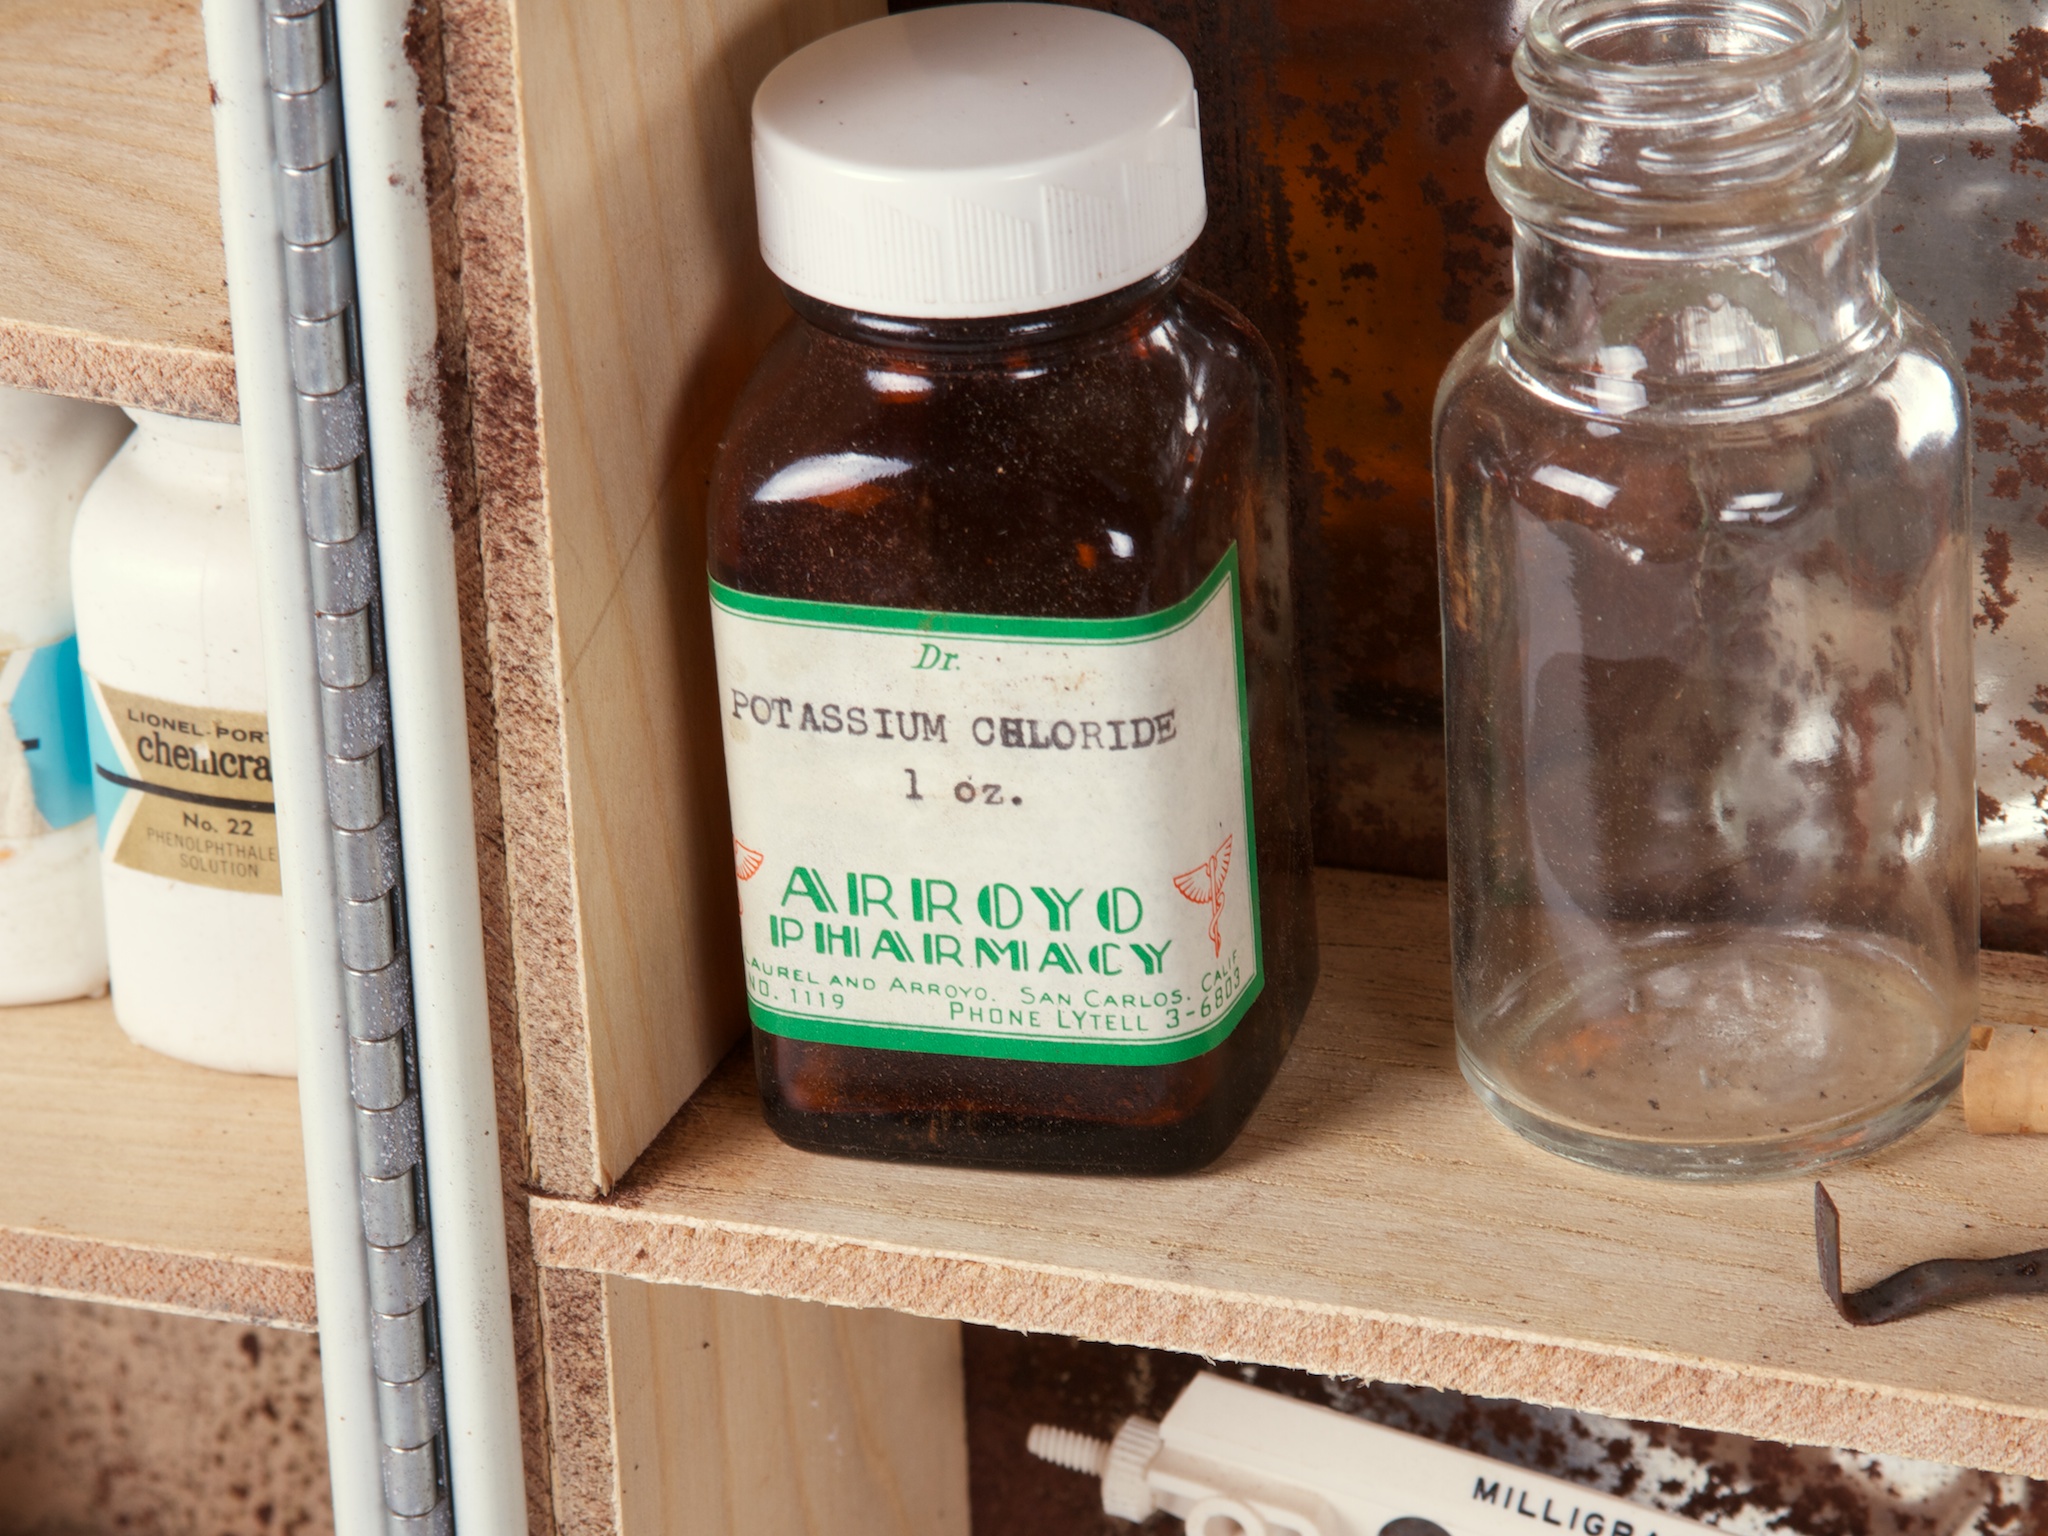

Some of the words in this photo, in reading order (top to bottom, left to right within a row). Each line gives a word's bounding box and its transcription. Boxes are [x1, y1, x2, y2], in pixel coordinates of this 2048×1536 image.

[911, 643, 961, 672] Dr.
[127, 708, 269, 744] LIONEL-POR
[731, 688, 949, 744] POTASSIUM
[971, 708, 1178, 750] CHLORIDE
[954, 778, 1023, 806] oz.
[147, 827, 277, 862] PHENOLPHTHALE
[183, 812, 218, 833] No.
[227, 818, 254, 837] 22
[180, 853, 259, 879] SOLUTION
[781, 866, 1143, 934] ARROYO
[769, 915, 1172, 976] PHARMACY
[790, 988, 844, 1010] 1119
[949, 1001, 1042, 1027] PHONE
[1057, 1009, 1150, 1031] LYTELL
[1165, 966, 1241, 1030] 3-6803
[829, 974, 876, 991] AND
[1020, 986, 1071, 1006] SAN
[1201, 949, 1238, 993] CALIF
[1472, 1477, 1658, 1536] MILLIGR
